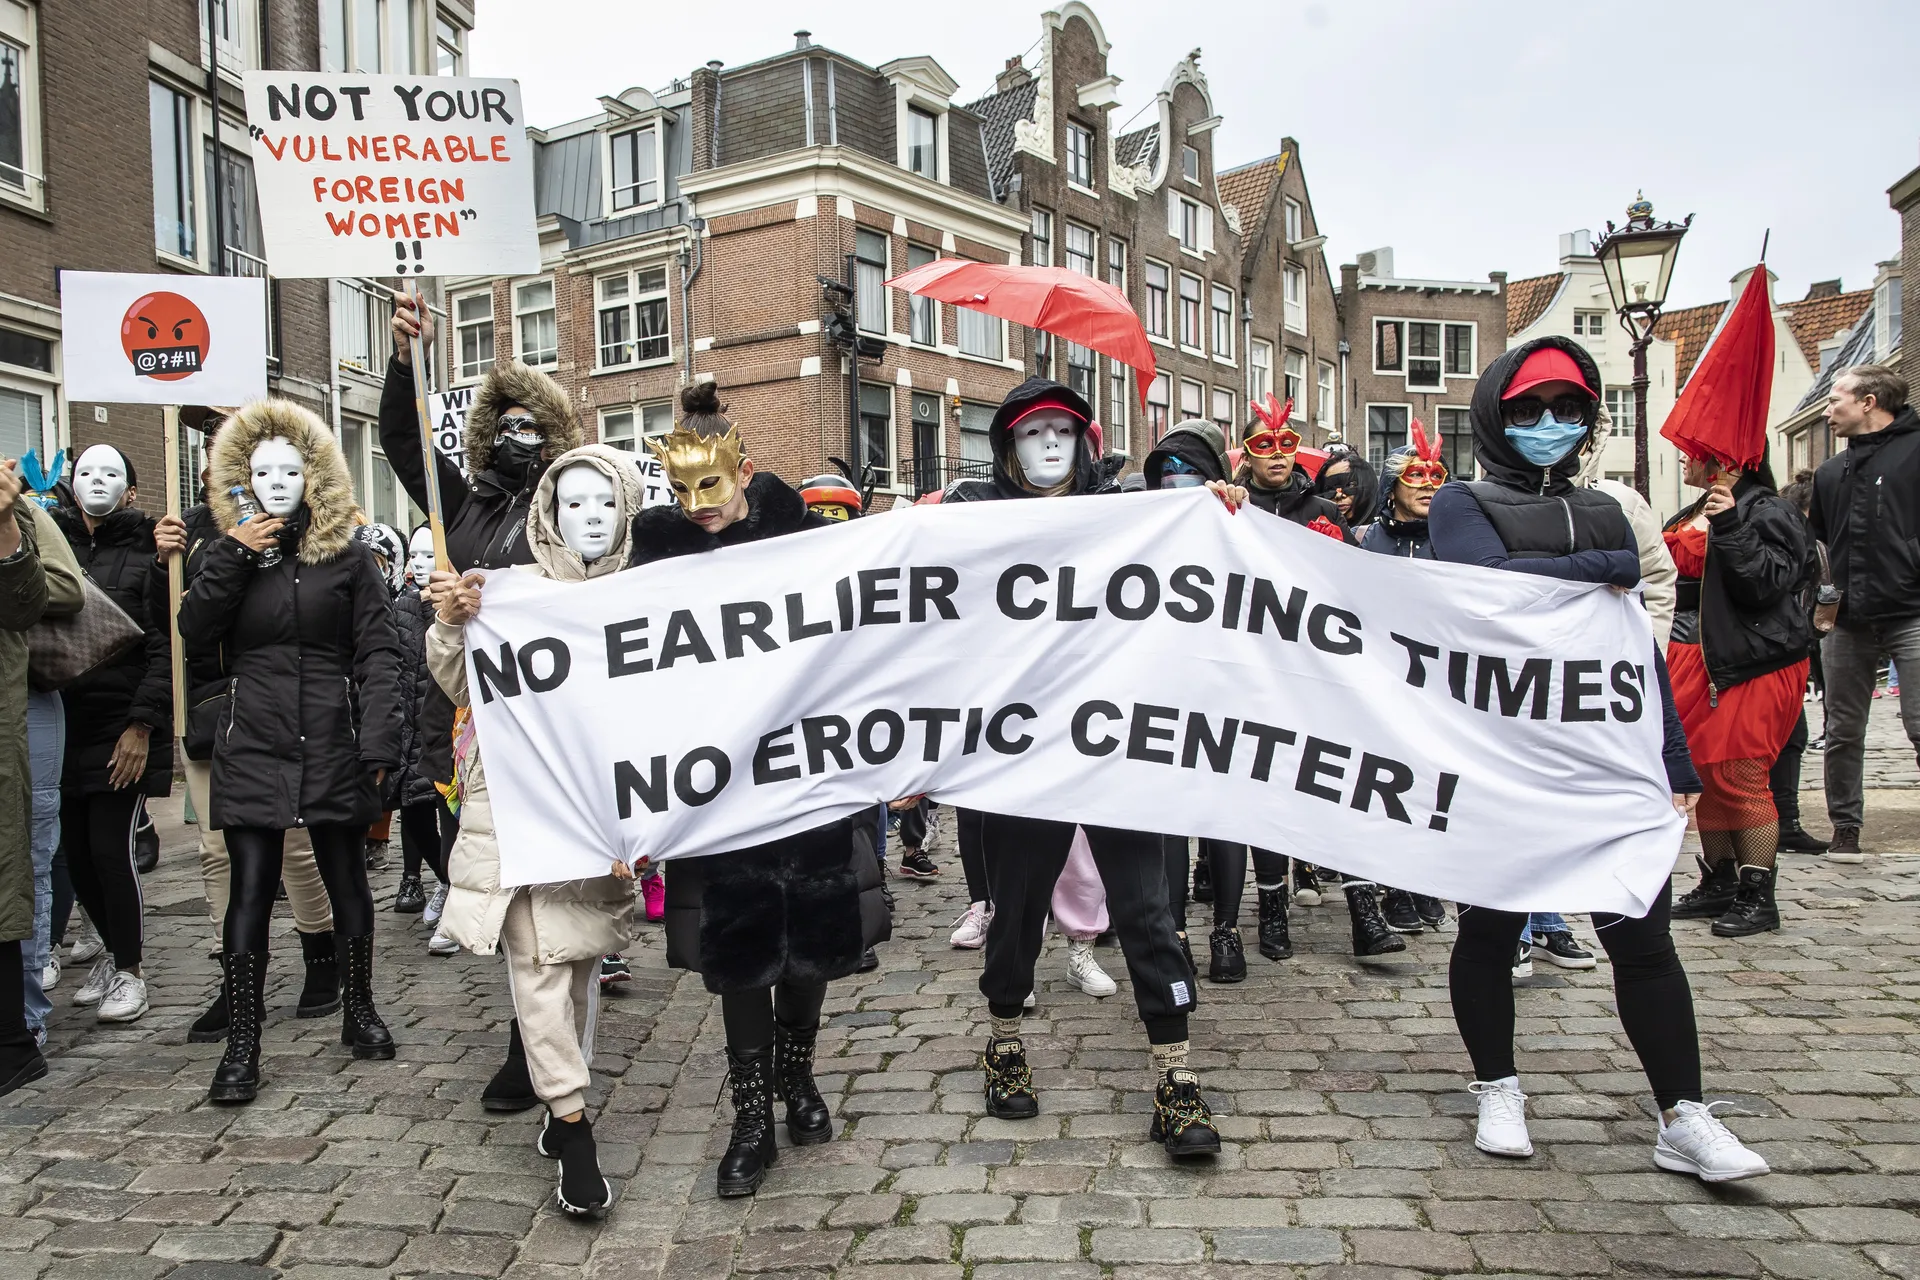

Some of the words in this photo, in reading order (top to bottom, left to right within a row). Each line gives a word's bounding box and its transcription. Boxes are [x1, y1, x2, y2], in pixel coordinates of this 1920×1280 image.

[267, 83, 370, 121] NOT
[393, 85, 514, 125] YOUR
[313, 176, 465, 204] FOREIGN
[472, 637, 571, 704] NO
[603, 566, 961, 679] EARLIER
[996, 563, 1363, 655] CLOSING
[613, 746, 732, 820] NO
[752, 702, 1038, 785] EROTIC
[1070, 699, 1460, 833] CENTER!
